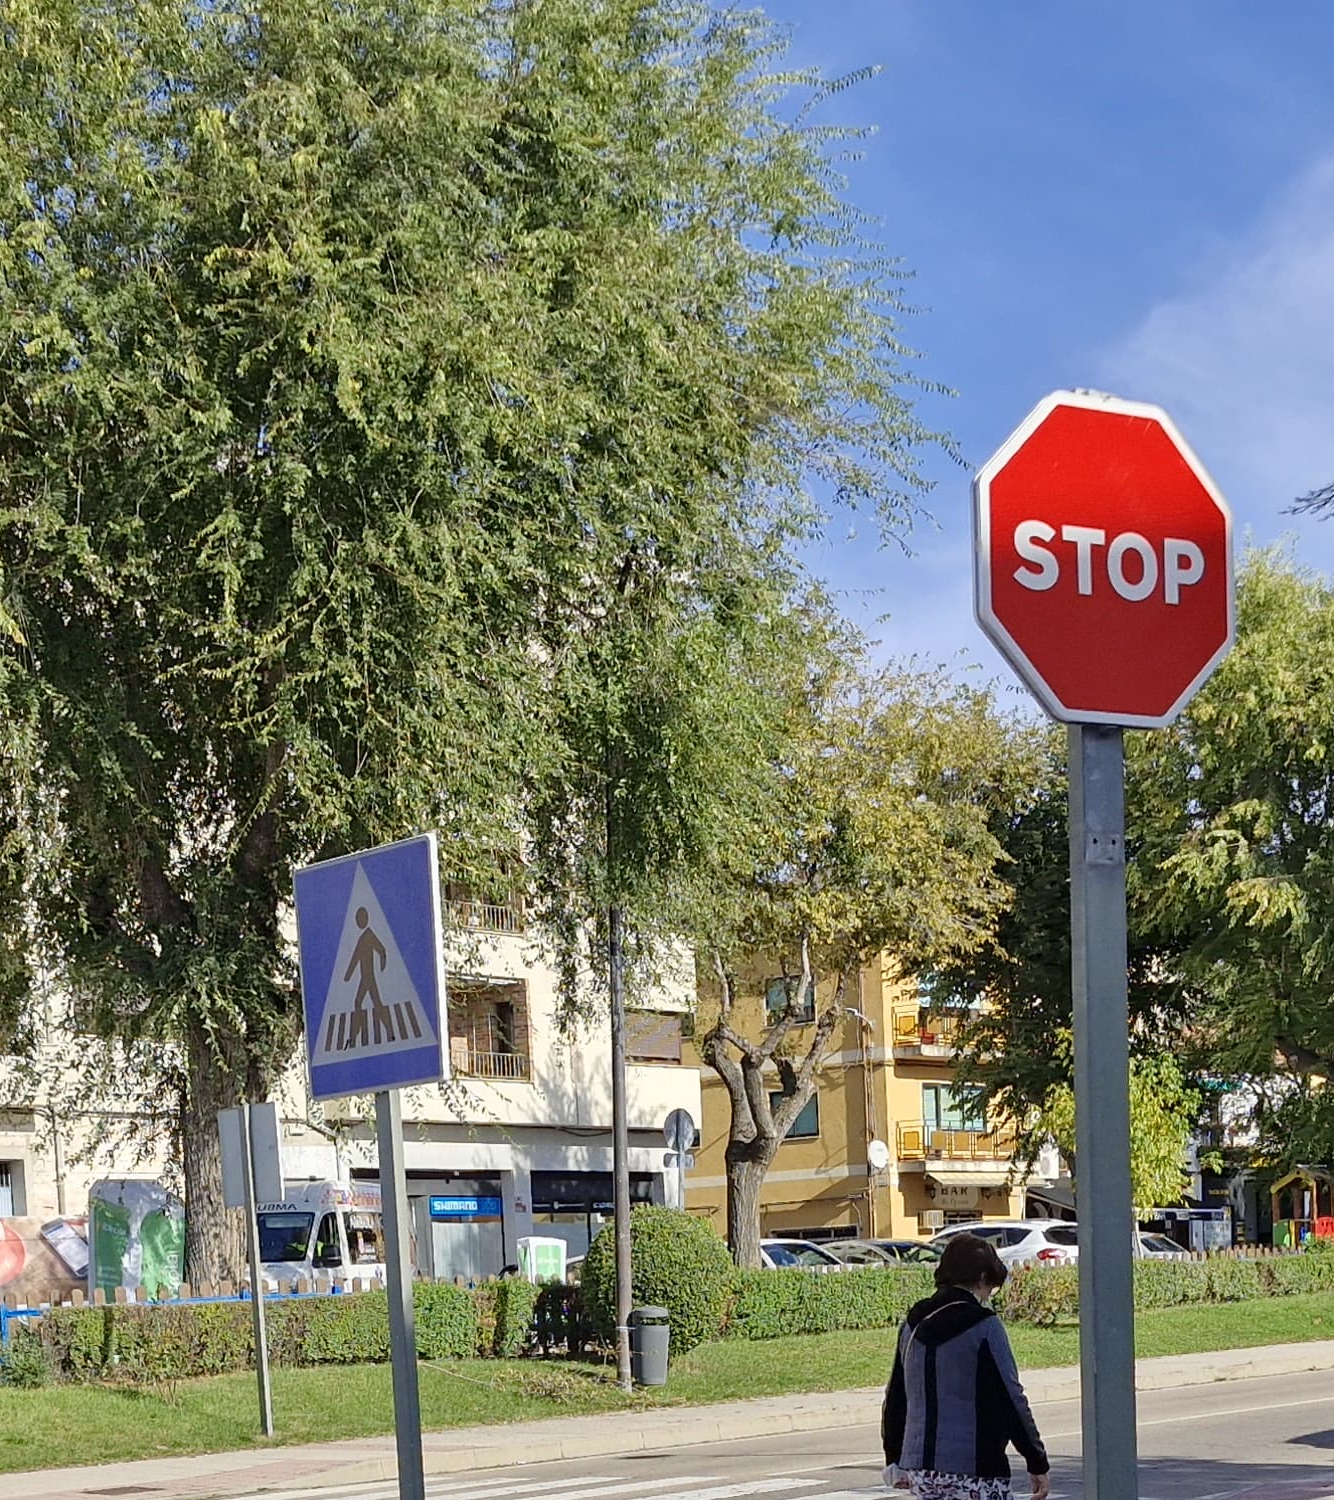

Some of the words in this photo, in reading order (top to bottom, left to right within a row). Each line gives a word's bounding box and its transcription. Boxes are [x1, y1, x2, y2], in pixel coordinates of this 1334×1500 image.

[1012, 519, 1206, 605] STOP
[941, 1186, 968, 1196] BAR
[433, 1200, 478, 1211] SHIMANO
